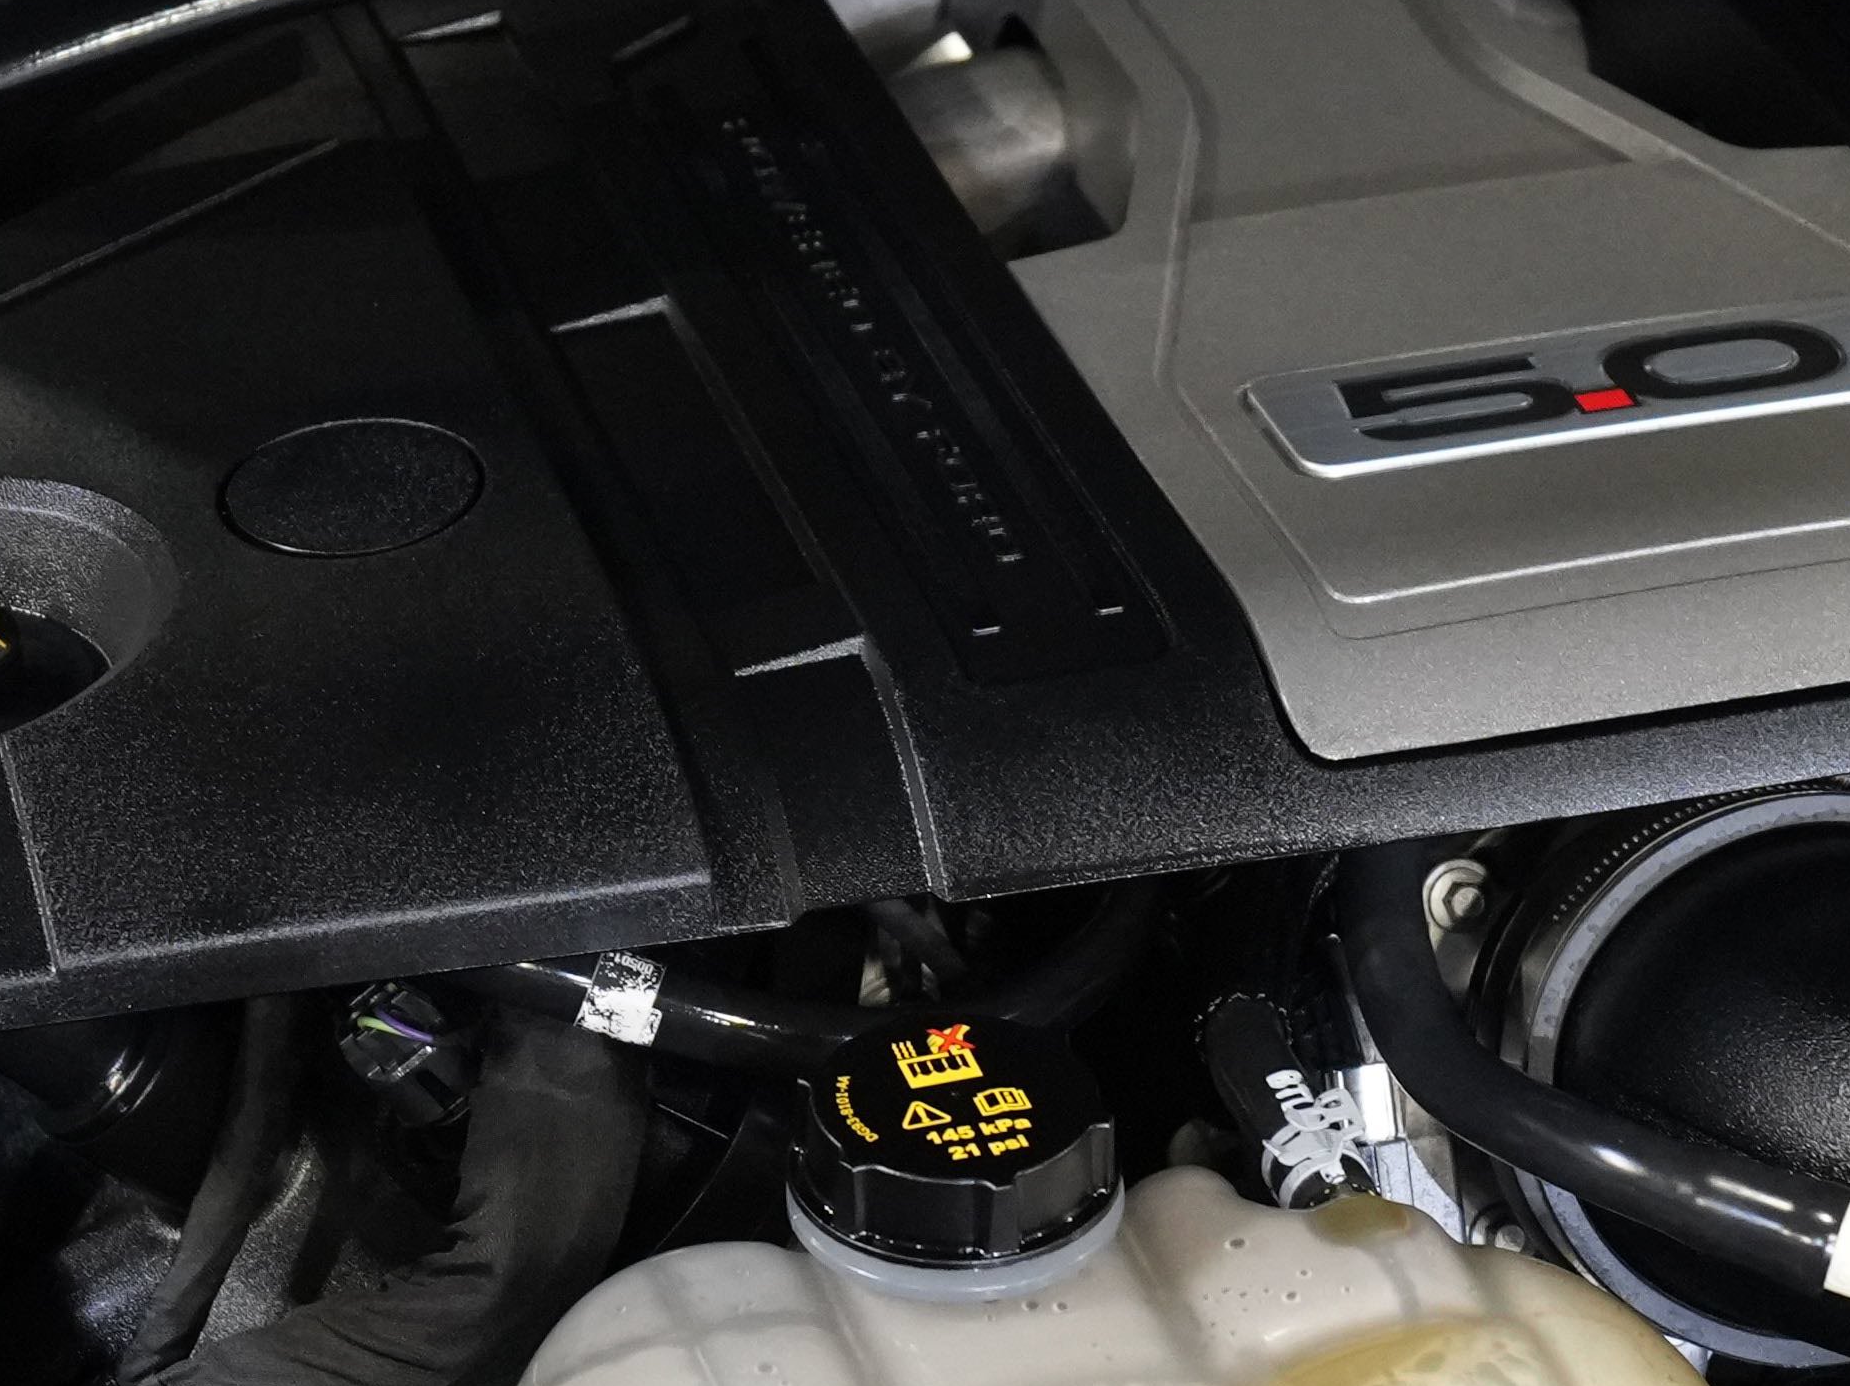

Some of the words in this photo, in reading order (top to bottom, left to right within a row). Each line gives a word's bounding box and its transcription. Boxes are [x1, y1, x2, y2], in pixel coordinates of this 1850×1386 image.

[1331, 317, 1846, 443] 5.0
[925, 1125, 976, 1146] 145
[978, 1116, 1033, 1137] kPa
[947, 1143, 982, 1162] 21
[988, 1133, 1030, 1157] psi
